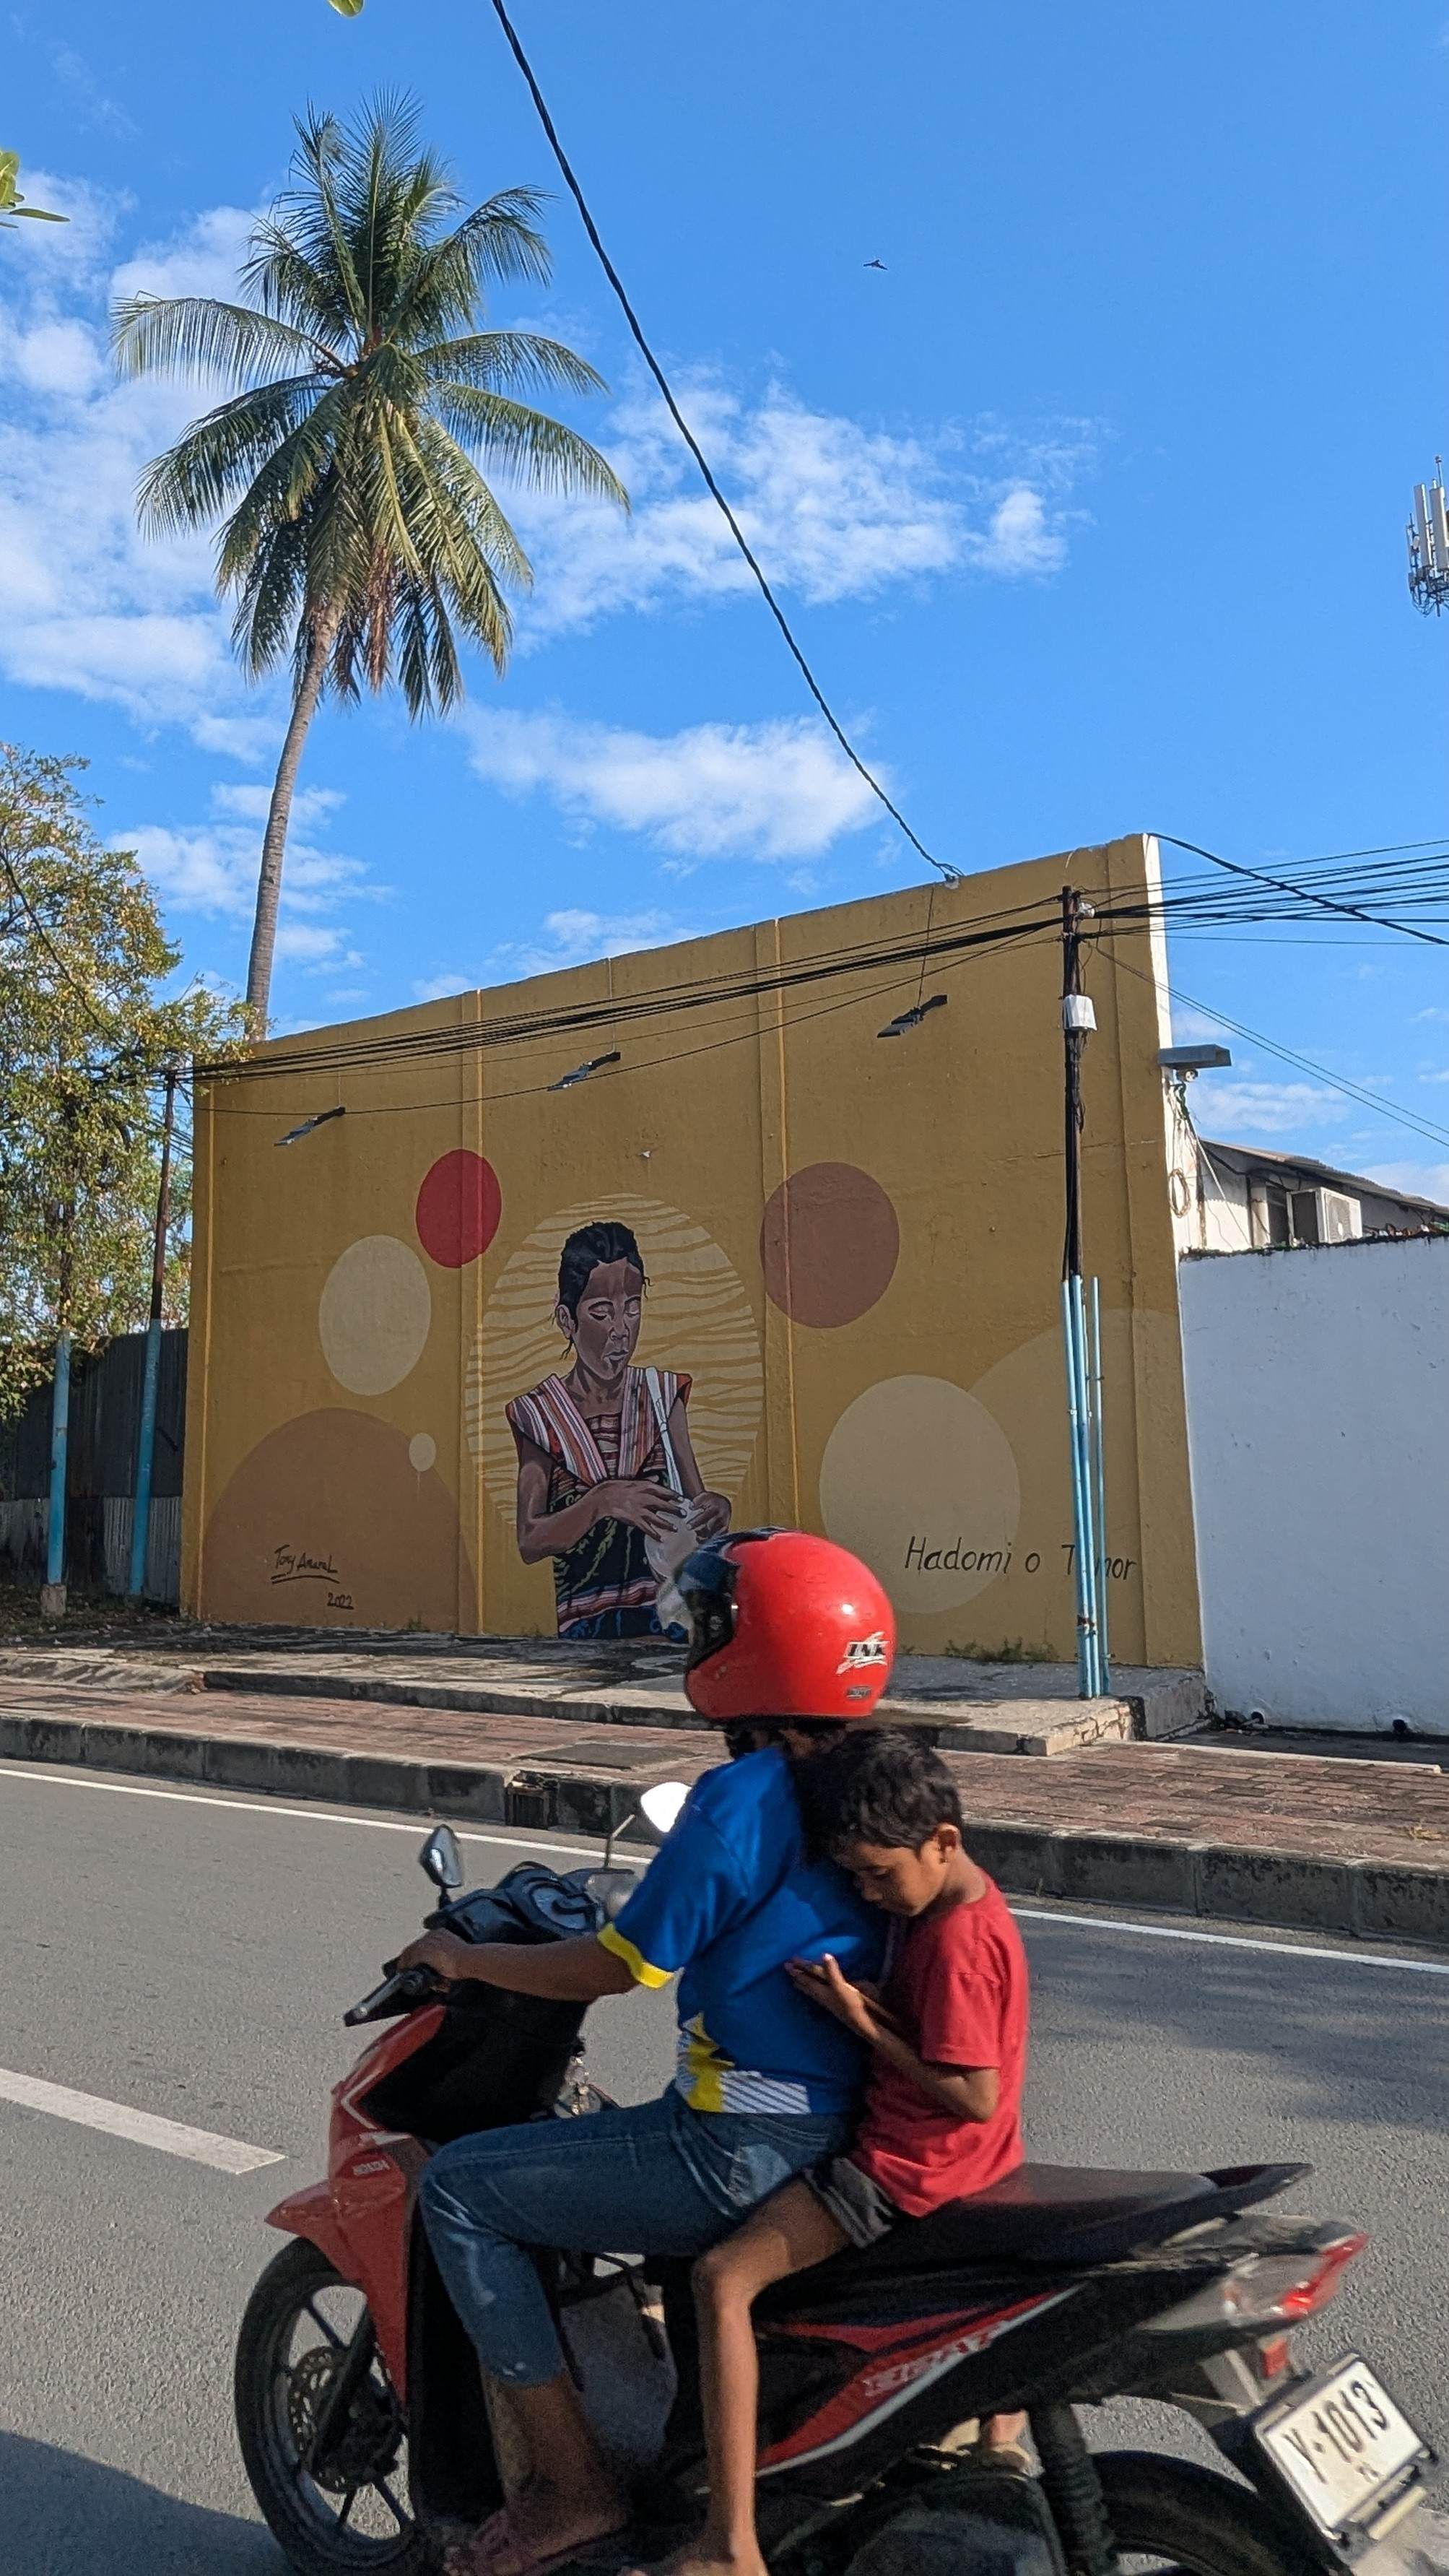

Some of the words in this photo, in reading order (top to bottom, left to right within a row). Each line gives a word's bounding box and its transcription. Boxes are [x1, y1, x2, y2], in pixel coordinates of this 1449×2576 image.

[905, 1535, 1011, 1575] Hadomi
[1024, 1552, 1040, 1573] o
[1061, 1544, 1137, 1580] Tmor
